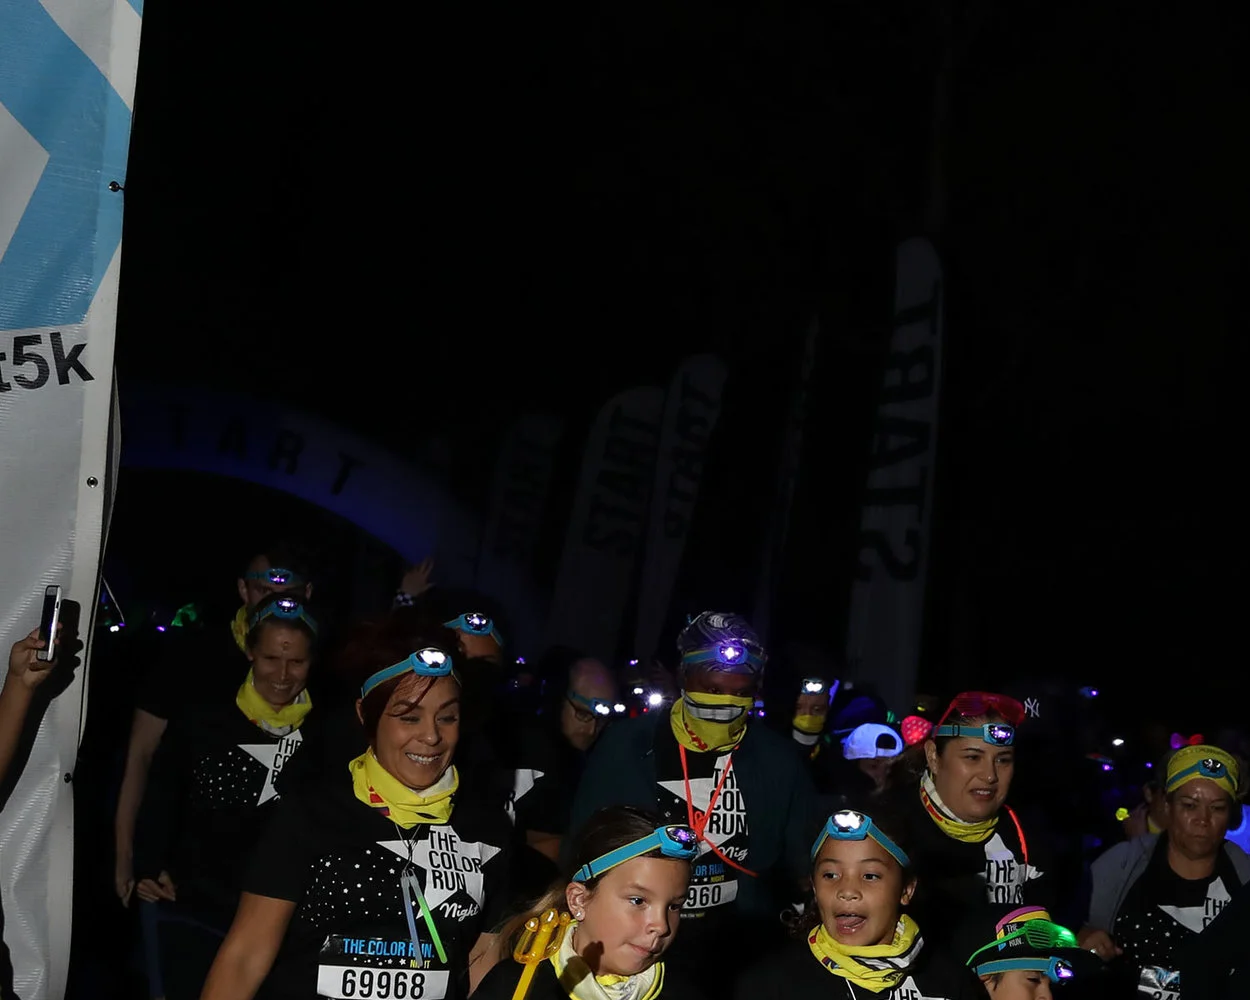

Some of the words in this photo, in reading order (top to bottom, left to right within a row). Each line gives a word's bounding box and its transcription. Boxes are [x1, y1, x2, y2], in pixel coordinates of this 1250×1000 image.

[429, 831, 458, 852] THE
[429, 852, 482, 874] COLOR
[985, 860, 1015, 883] THE
[432, 870, 467, 891] RUN
[687, 885, 721, 907] 960
[439, 902, 480, 922] Night
[343, 937, 366, 954] THE
[367, 939, 407, 957] COLOR
[342, 969, 425, 999] 69968
